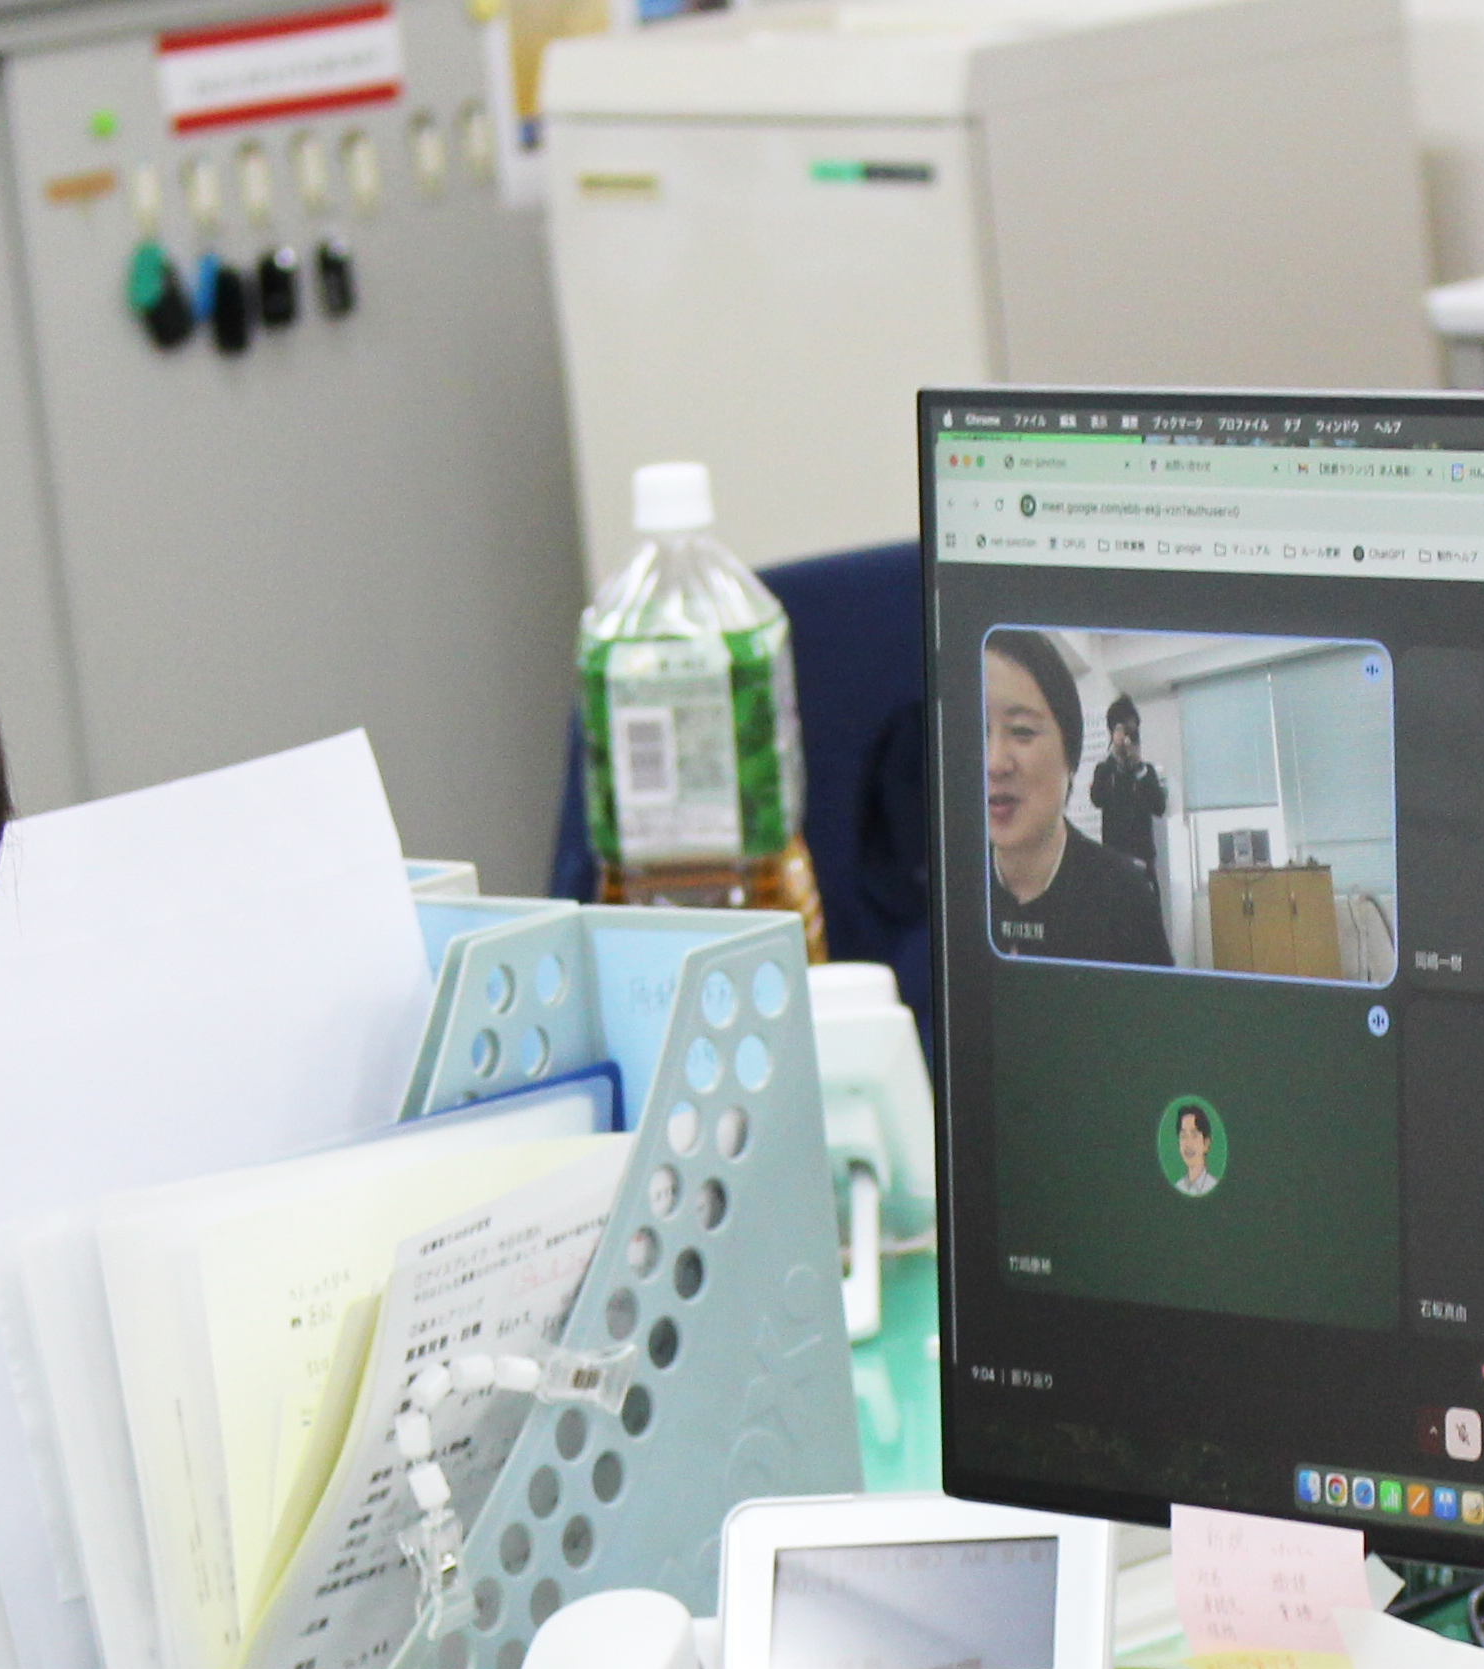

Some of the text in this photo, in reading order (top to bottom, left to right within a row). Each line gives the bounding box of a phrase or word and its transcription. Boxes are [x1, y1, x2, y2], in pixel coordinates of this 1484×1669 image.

[1014, 414, 1047, 428] ファイル
[1152, 415, 1203, 431] ブックマーク
[1218, 416, 1269, 432] プロファイル
[1284, 418, 1302, 433] タブ
[1316, 418, 1360, 433] ウィンドウ
[1374, 419, 1402, 434] ヘルプ
